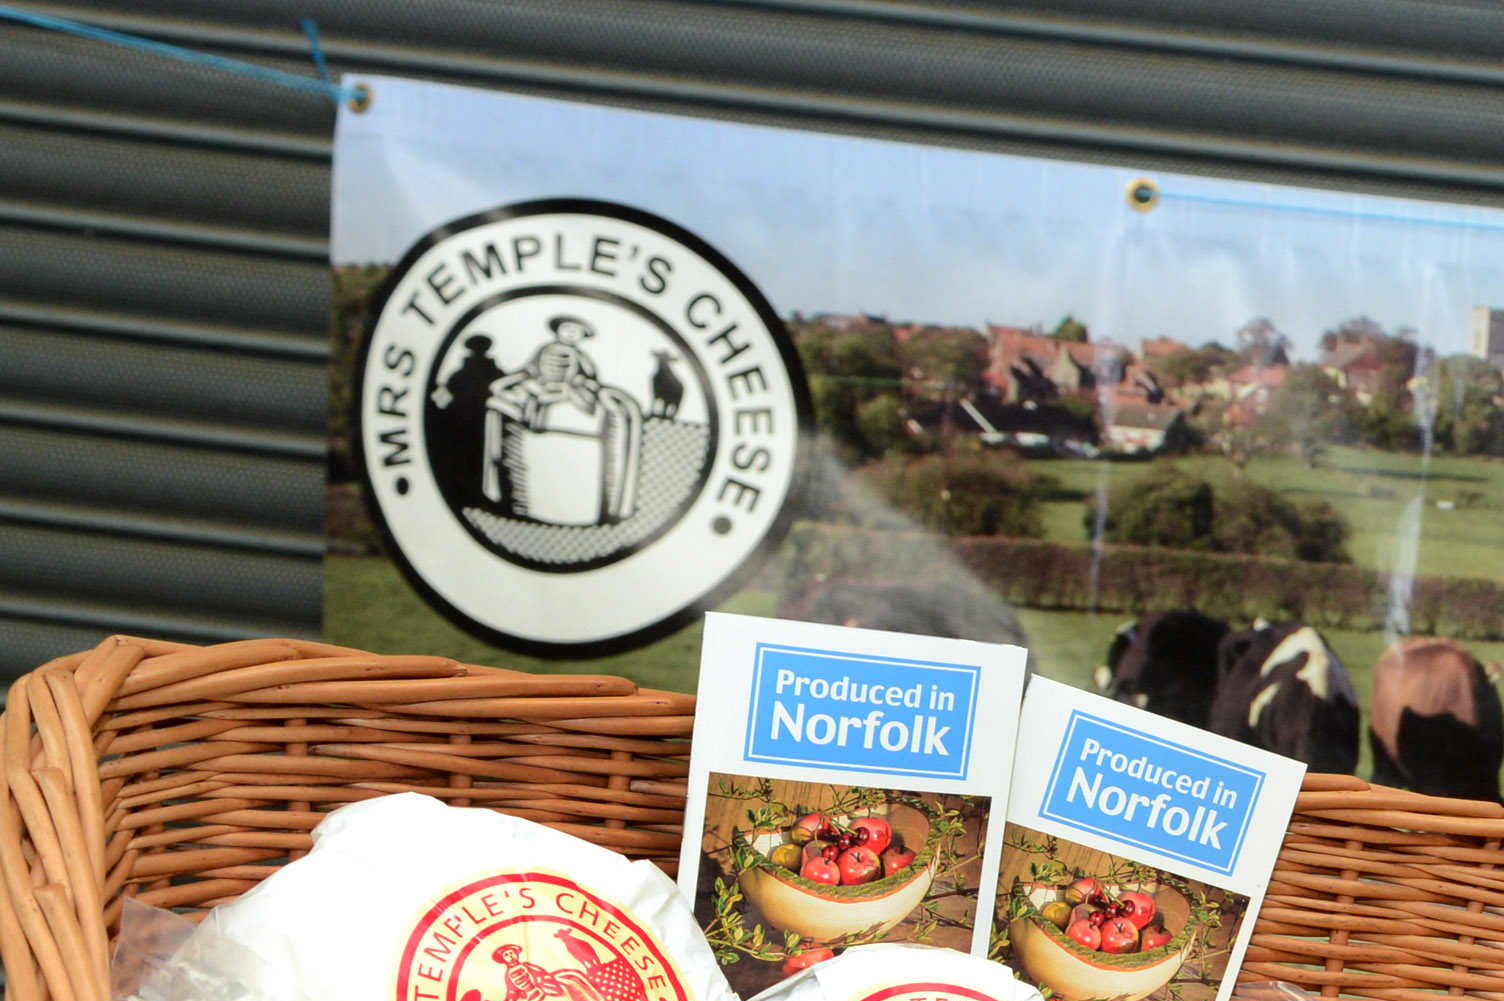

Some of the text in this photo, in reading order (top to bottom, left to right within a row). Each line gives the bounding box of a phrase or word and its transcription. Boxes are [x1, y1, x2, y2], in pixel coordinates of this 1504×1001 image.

[377, 232, 775, 514] MRS TEMPLE'S CHEESE
[769, 700, 950, 757] Norfolk
[775, 669, 955, 711] Produced in
[1066, 766, 1229, 850] Norfolk
[1081, 737, 1238, 809] Produced in
[555, 892, 668, 993] CHEESE
